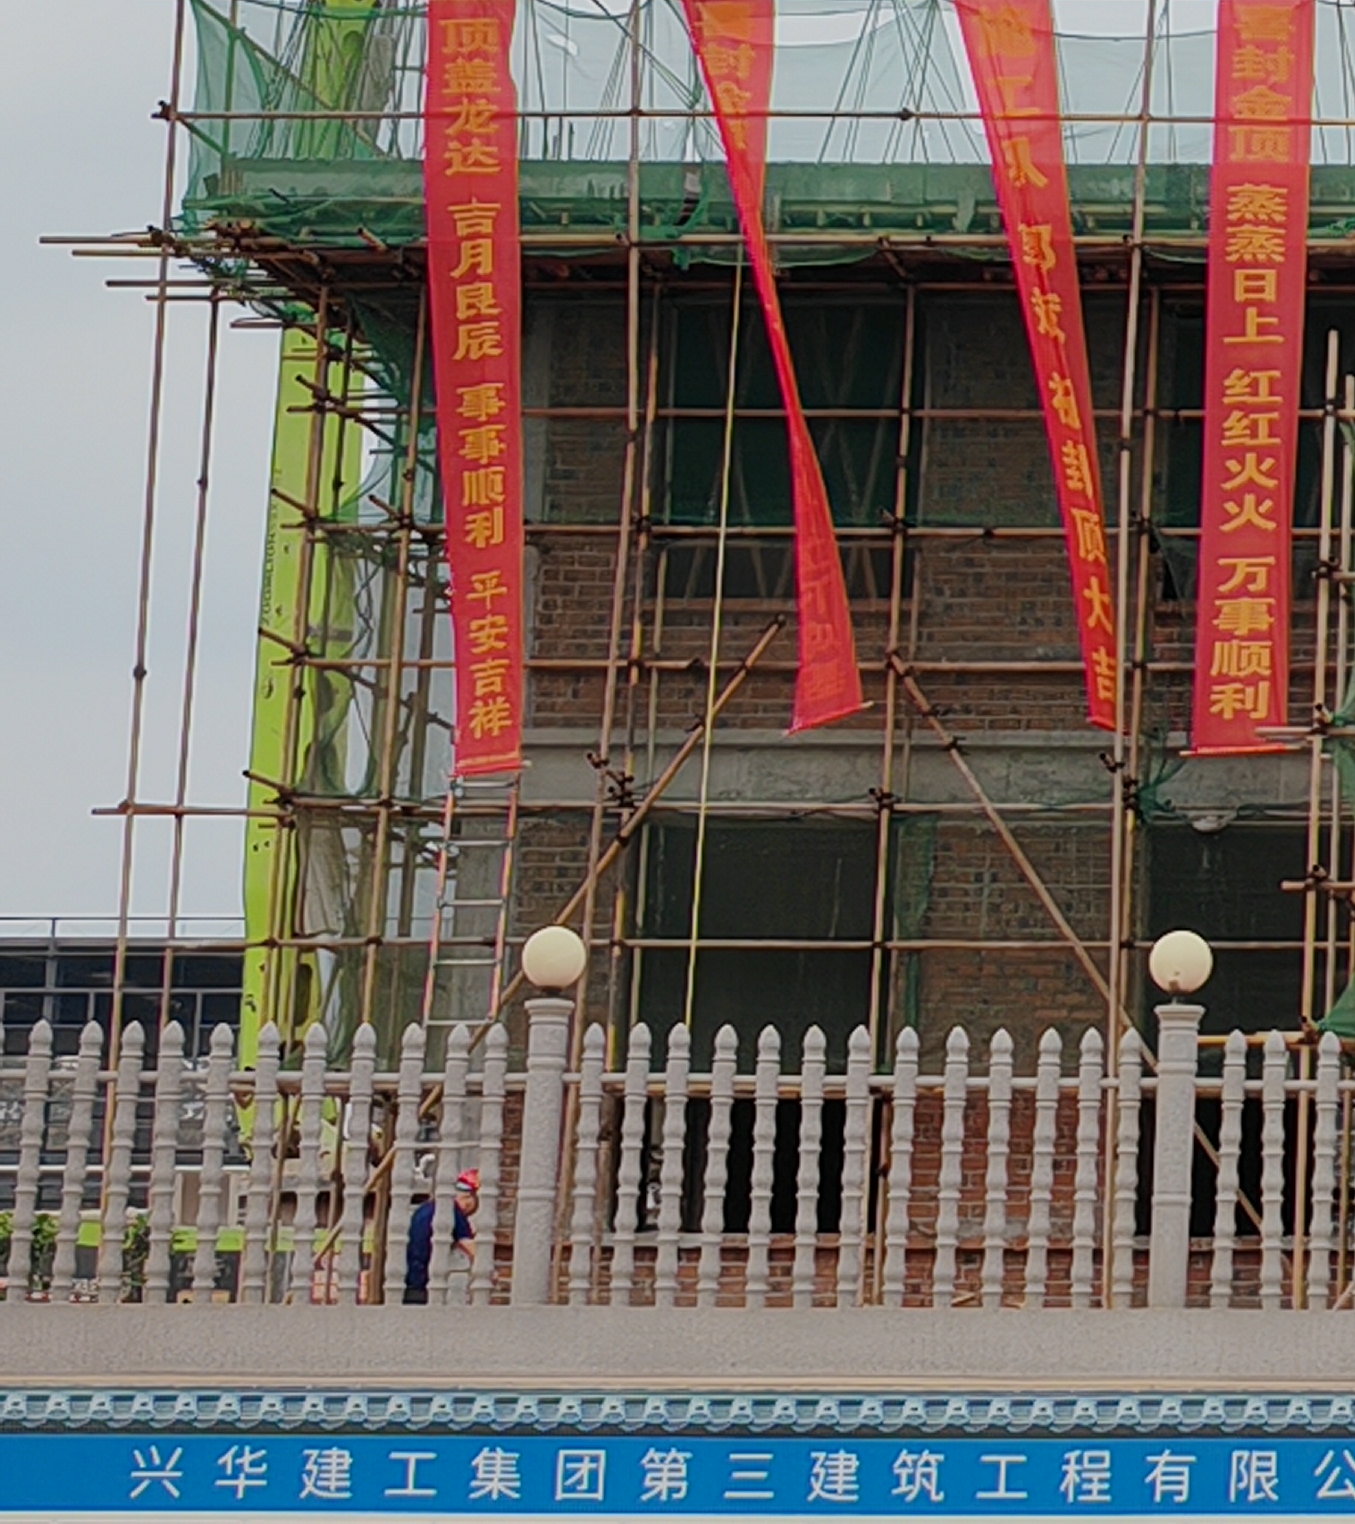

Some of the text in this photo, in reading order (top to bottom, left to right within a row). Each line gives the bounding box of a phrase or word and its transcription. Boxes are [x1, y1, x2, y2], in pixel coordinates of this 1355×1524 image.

[446, 197, 504, 361] 吉月良辰
[1209, 4, 1295, 720] 喜封金顶 蒸蒸日上 红红火火 万事顺利
[455, 382, 508, 549] 事事顺利
[465, 569, 513, 739] 平安吉祥
